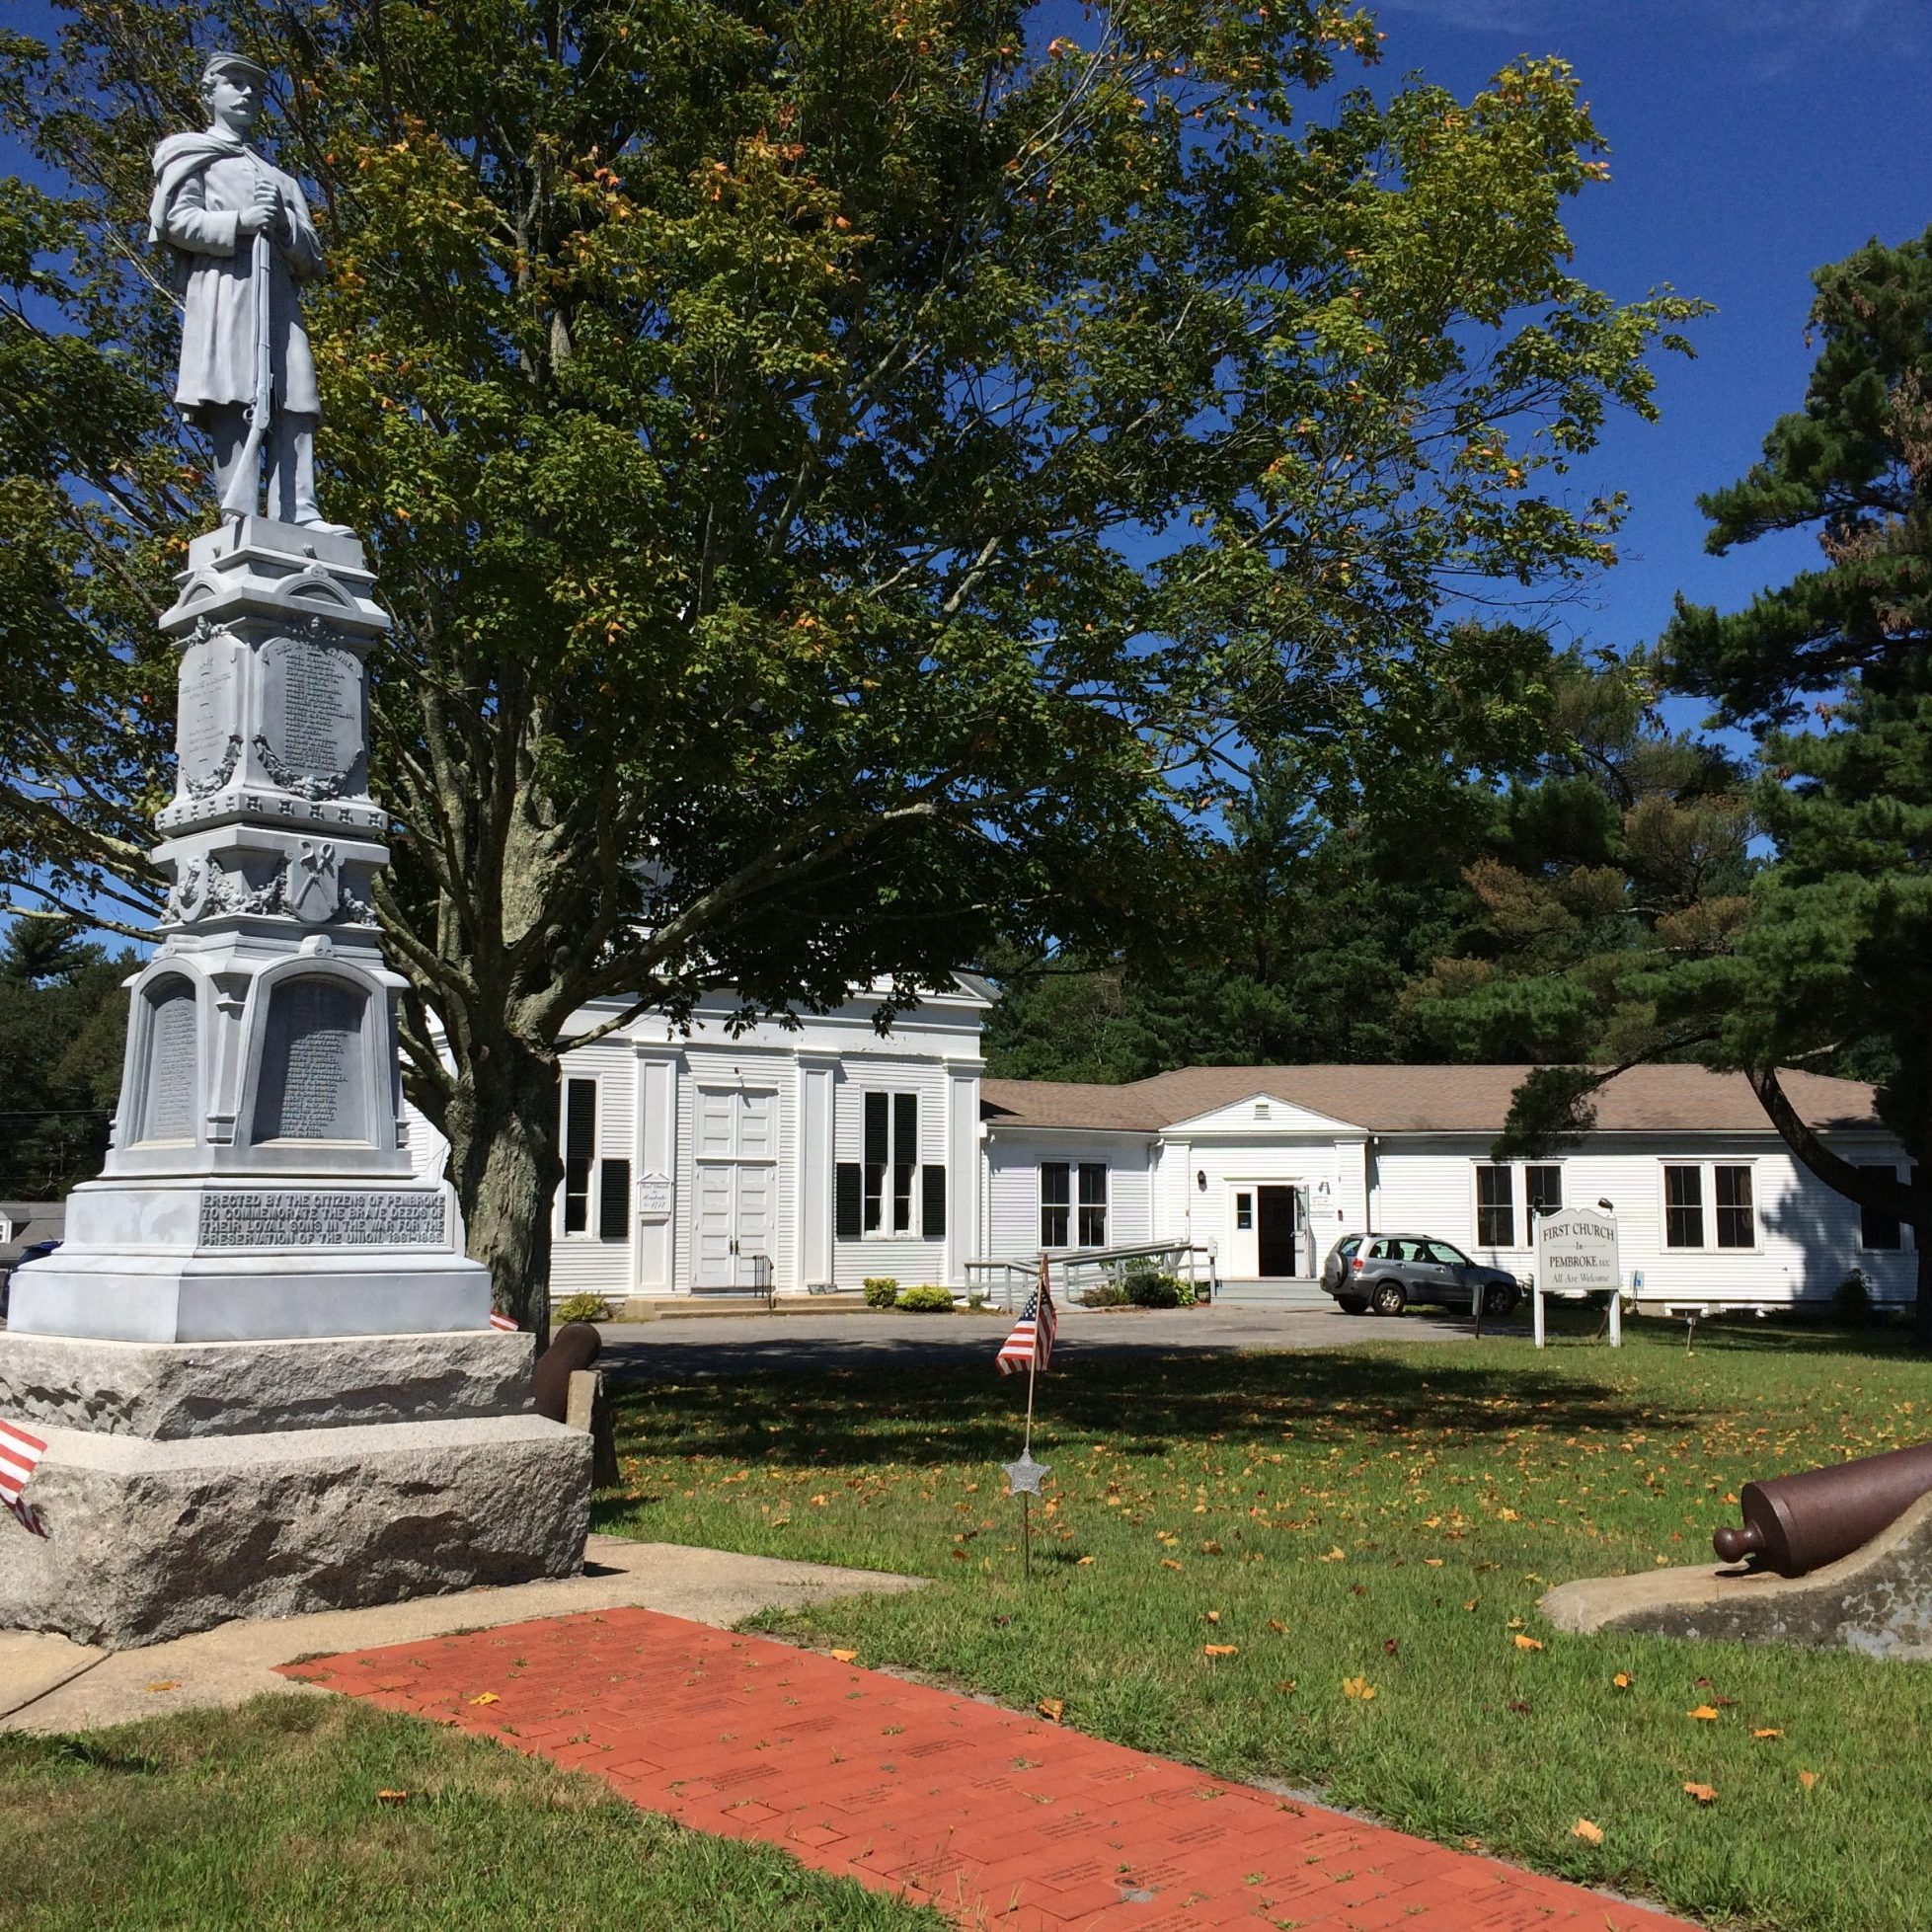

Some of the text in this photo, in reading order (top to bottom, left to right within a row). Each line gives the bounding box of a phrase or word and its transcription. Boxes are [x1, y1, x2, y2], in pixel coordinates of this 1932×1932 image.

[203, 1195, 445, 1207] ERECTED BY THE CITIZENS OF PEMBROKE
[202, 1207, 445, 1221] TO COMMEMORATE THE BRAVE DEEDS OF
[201, 1220, 444, 1233] THEIR LOYAL SONS IN THE WAR FOR THE
[1543, 1223, 1614, 1241] FIRST CHURCH
[200, 1233, 295, 1246] PRESERVATION
[298, 1233, 315, 1245] OF
[319, 1233, 342, 1244] THE
[1549, 1256, 1597, 1268] PEMBROKE
[1554, 1273, 1610, 1282] All Are Welcome
